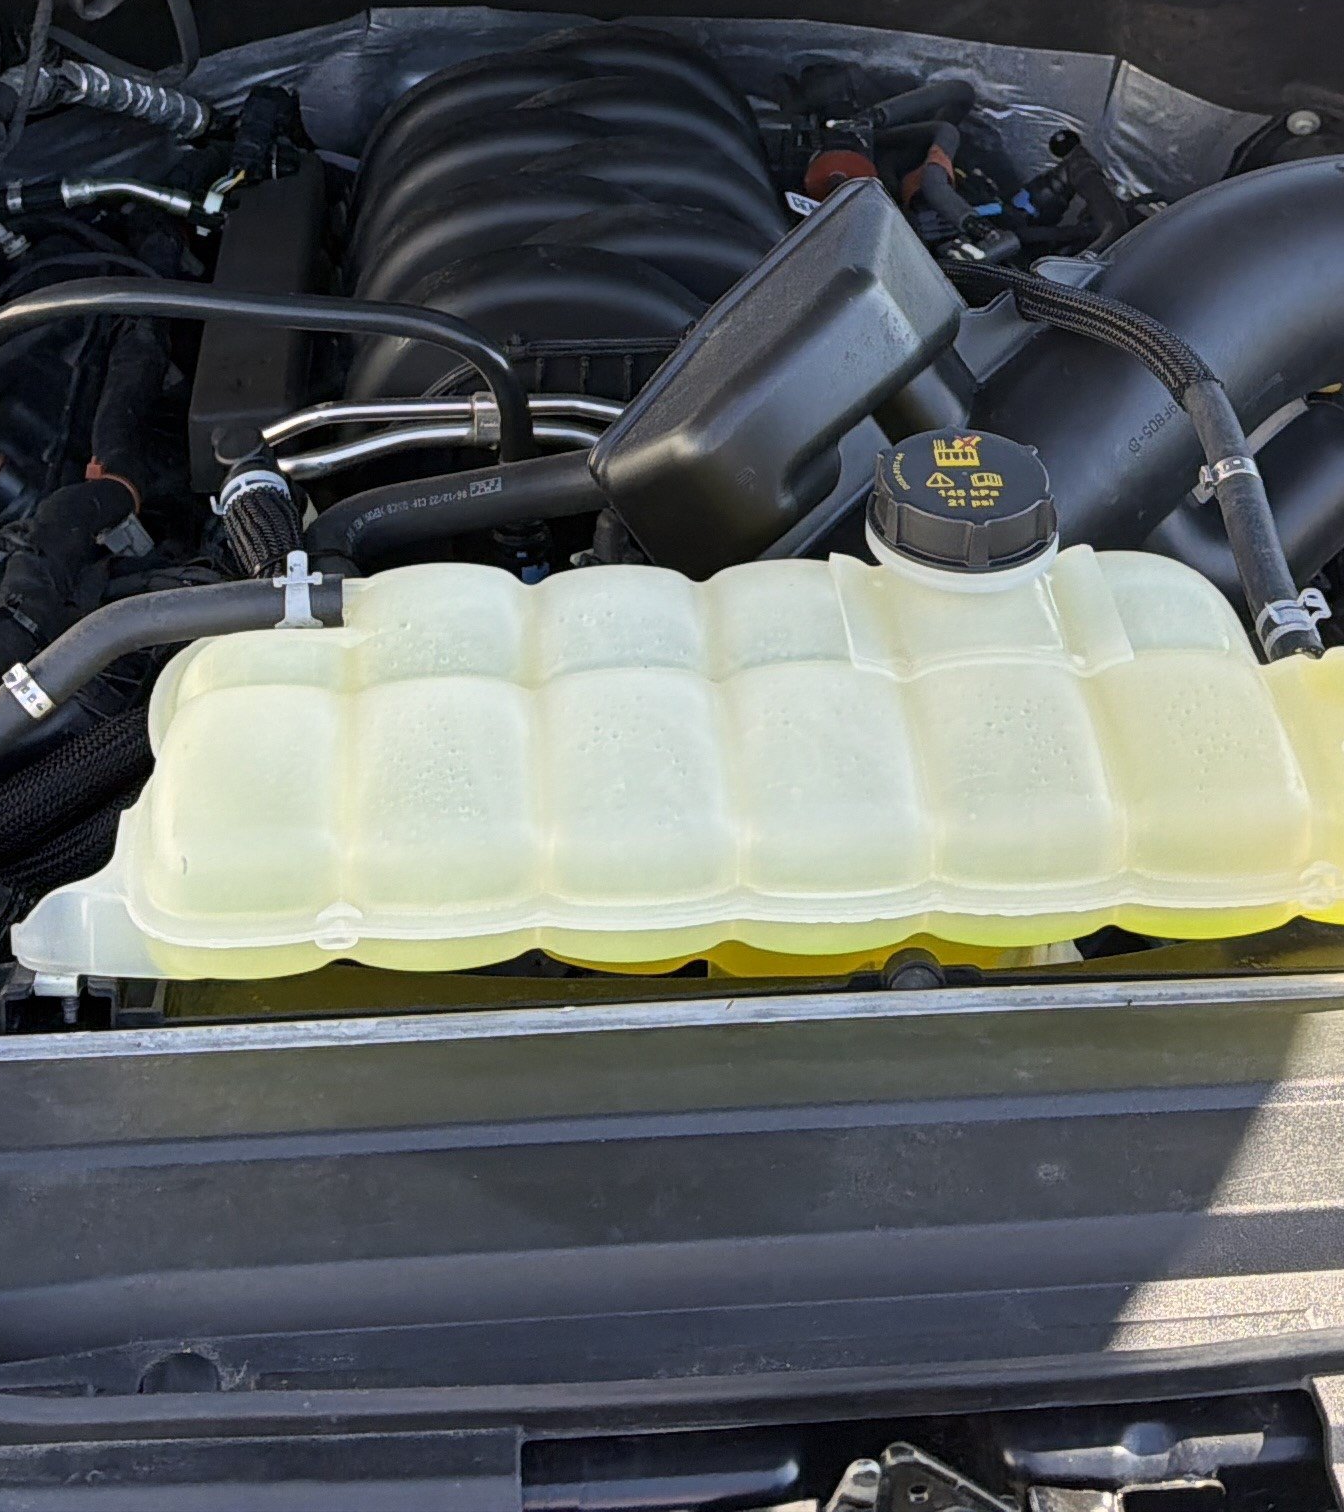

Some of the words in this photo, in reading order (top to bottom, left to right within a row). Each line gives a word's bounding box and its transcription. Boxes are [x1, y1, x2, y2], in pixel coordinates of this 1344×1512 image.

[938, 489, 966, 497] 145
[970, 489, 999, 497] kPa
[948, 498, 966, 507] 21
